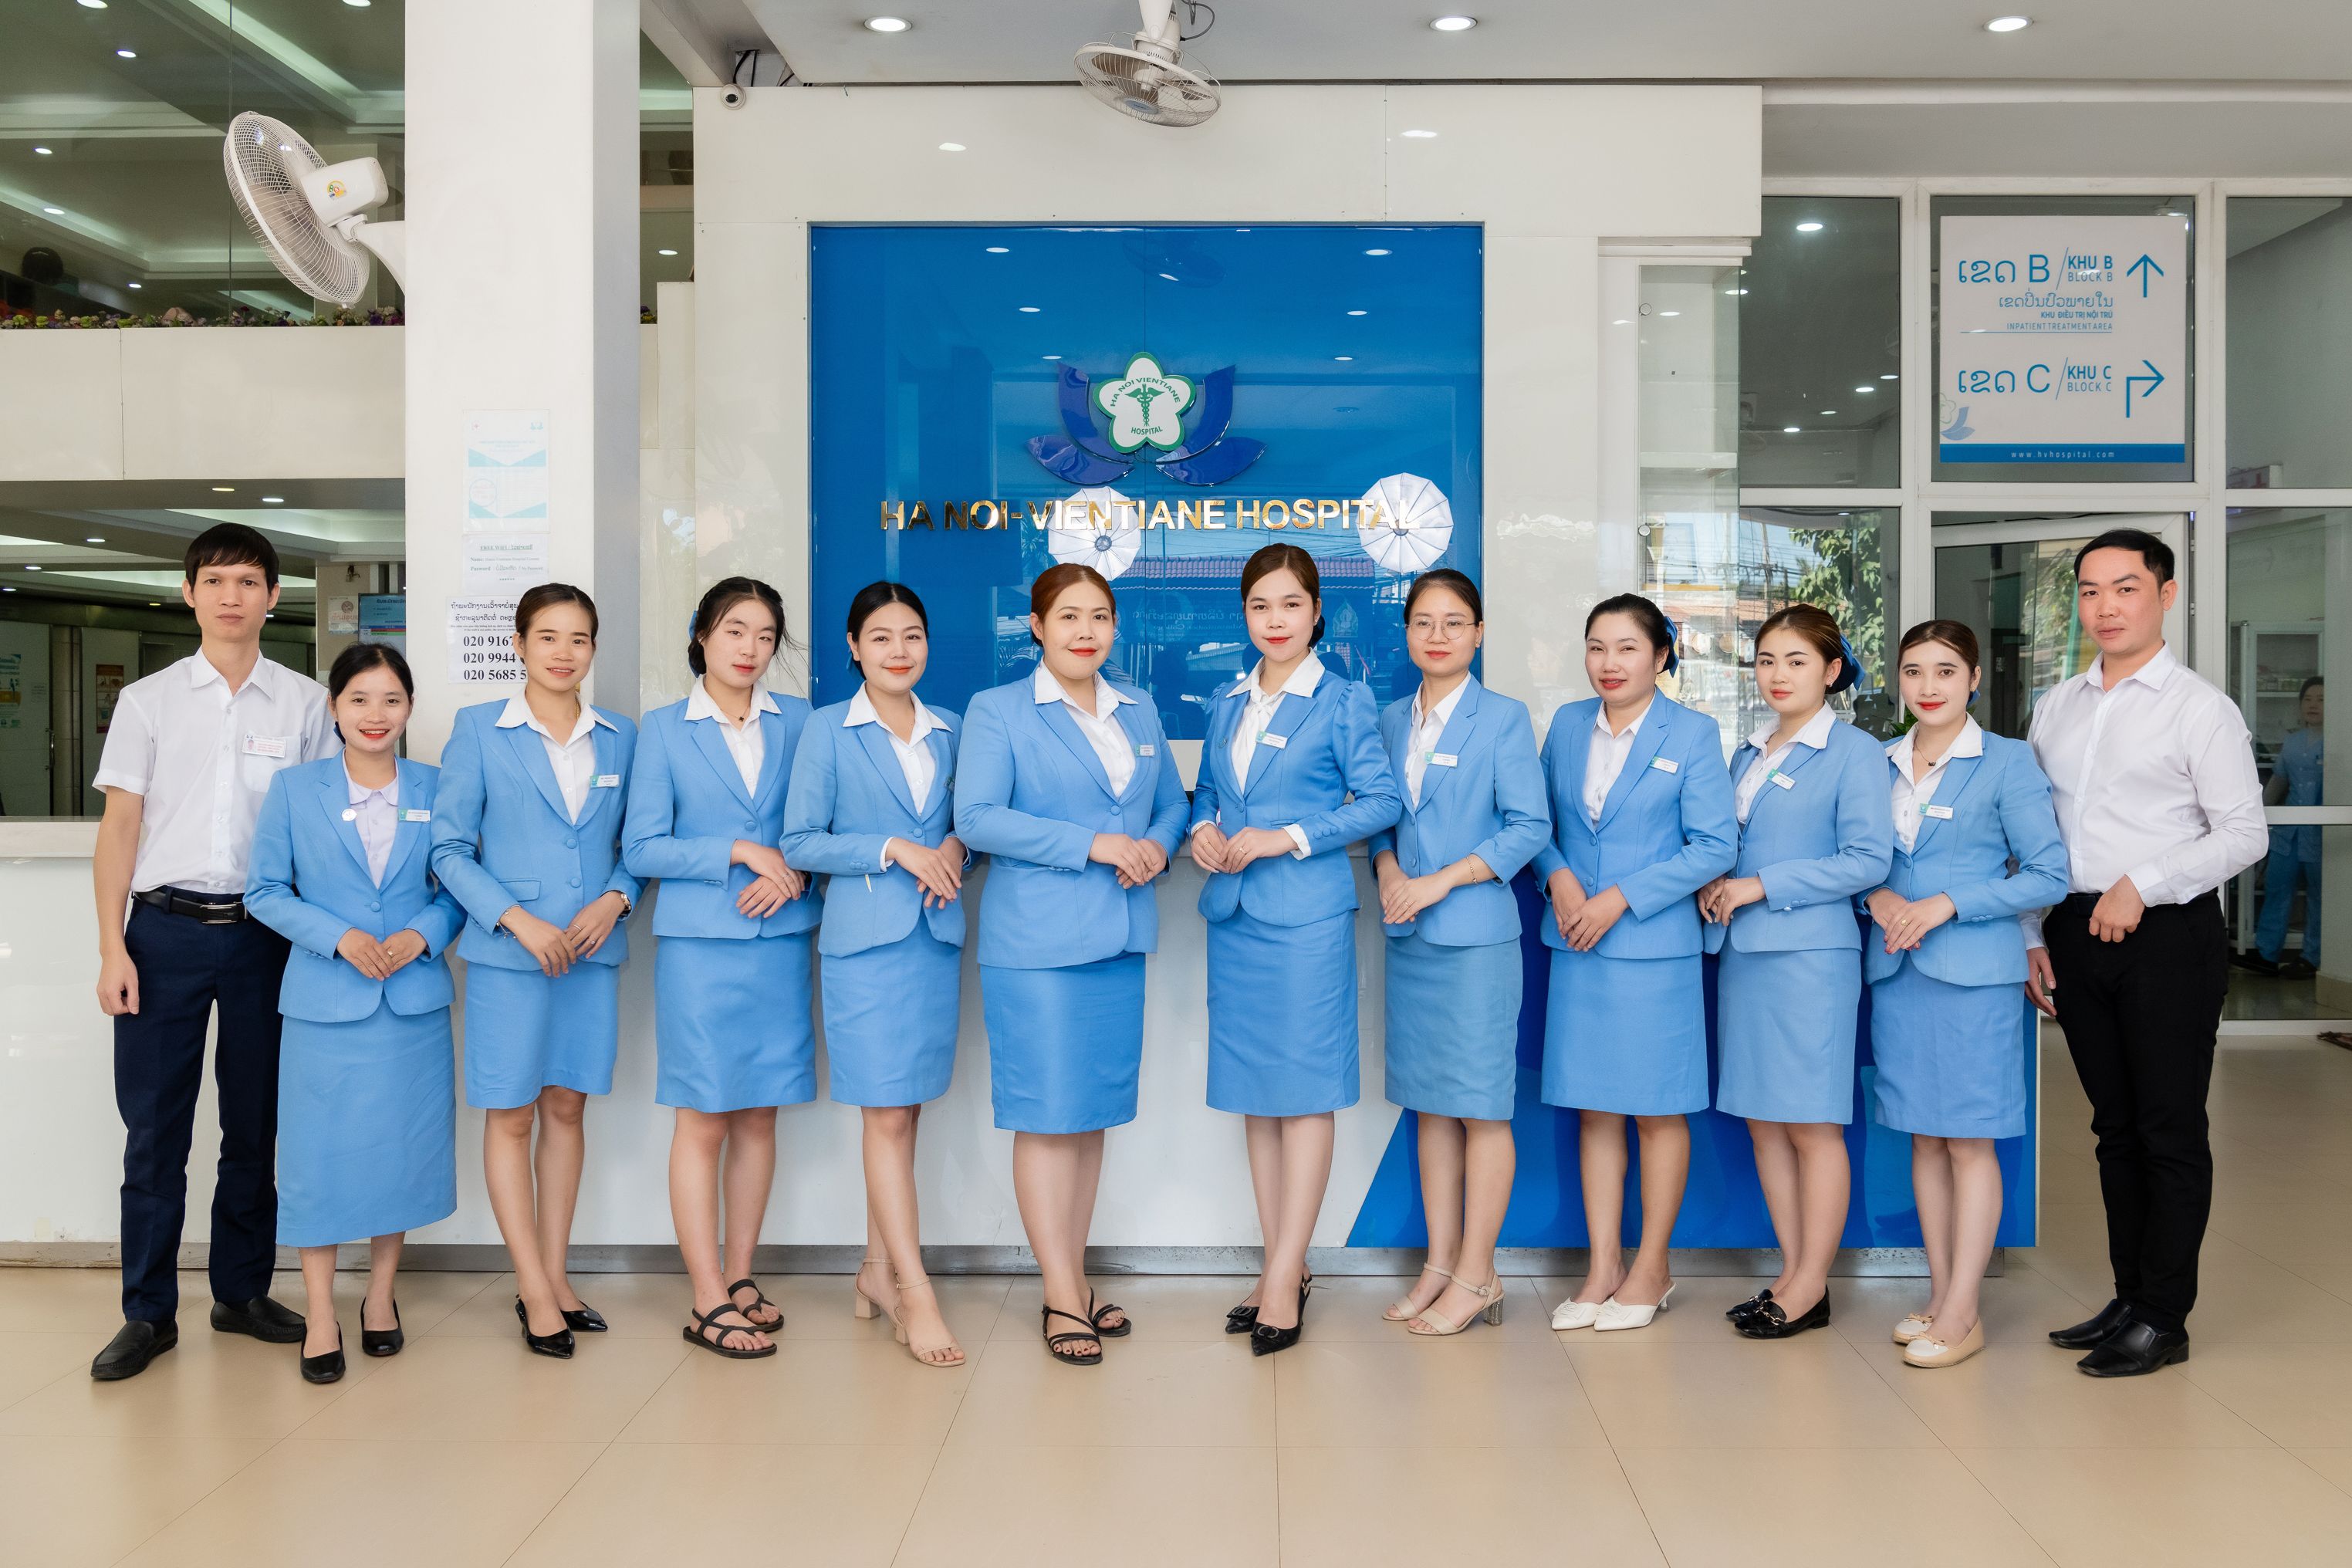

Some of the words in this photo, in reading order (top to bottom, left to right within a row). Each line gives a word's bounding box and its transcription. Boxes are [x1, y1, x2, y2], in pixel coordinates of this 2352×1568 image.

[2068, 255, 2097, 269] KHU
[2104, 255, 2113, 269] B
[1958, 259, 2016, 283] ເຂດ
[2029, 254, 2050, 283] B
[2068, 272, 2102, 282] BLOCK
[2107, 272, 2113, 282] B
[1958, 370, 2016, 393] ເຂດ
[2027, 363, 2050, 393] C
[2067, 366, 2097, 380] KHU
[2104, 366, 2112, 380] C
[1110, 393, 1120, 407] HA
[1118, 380, 1135, 393] NOI
[1136, 377, 1181, 403] VIENTIANE
[2067, 382, 2101, 392] BLOCK
[2106, 382, 2112, 392] C
[1130, 426, 1164, 435] HOSPITAL
[2011, 451, 2115, 459] www.hvhospital.com
[880, 500, 934, 531] HA
[945, 499, 1226, 531] NOI-VIENTIANE
[1236, 498, 1421, 530] HOSPITAL
[463, 635, 484, 647] 020
[463, 652, 485, 664] 020
[488, 652, 516, 664] 9944
[464, 669, 485, 681] 020
[488, 669, 516, 681] 5685
[520, 669, 526, 681] 5
